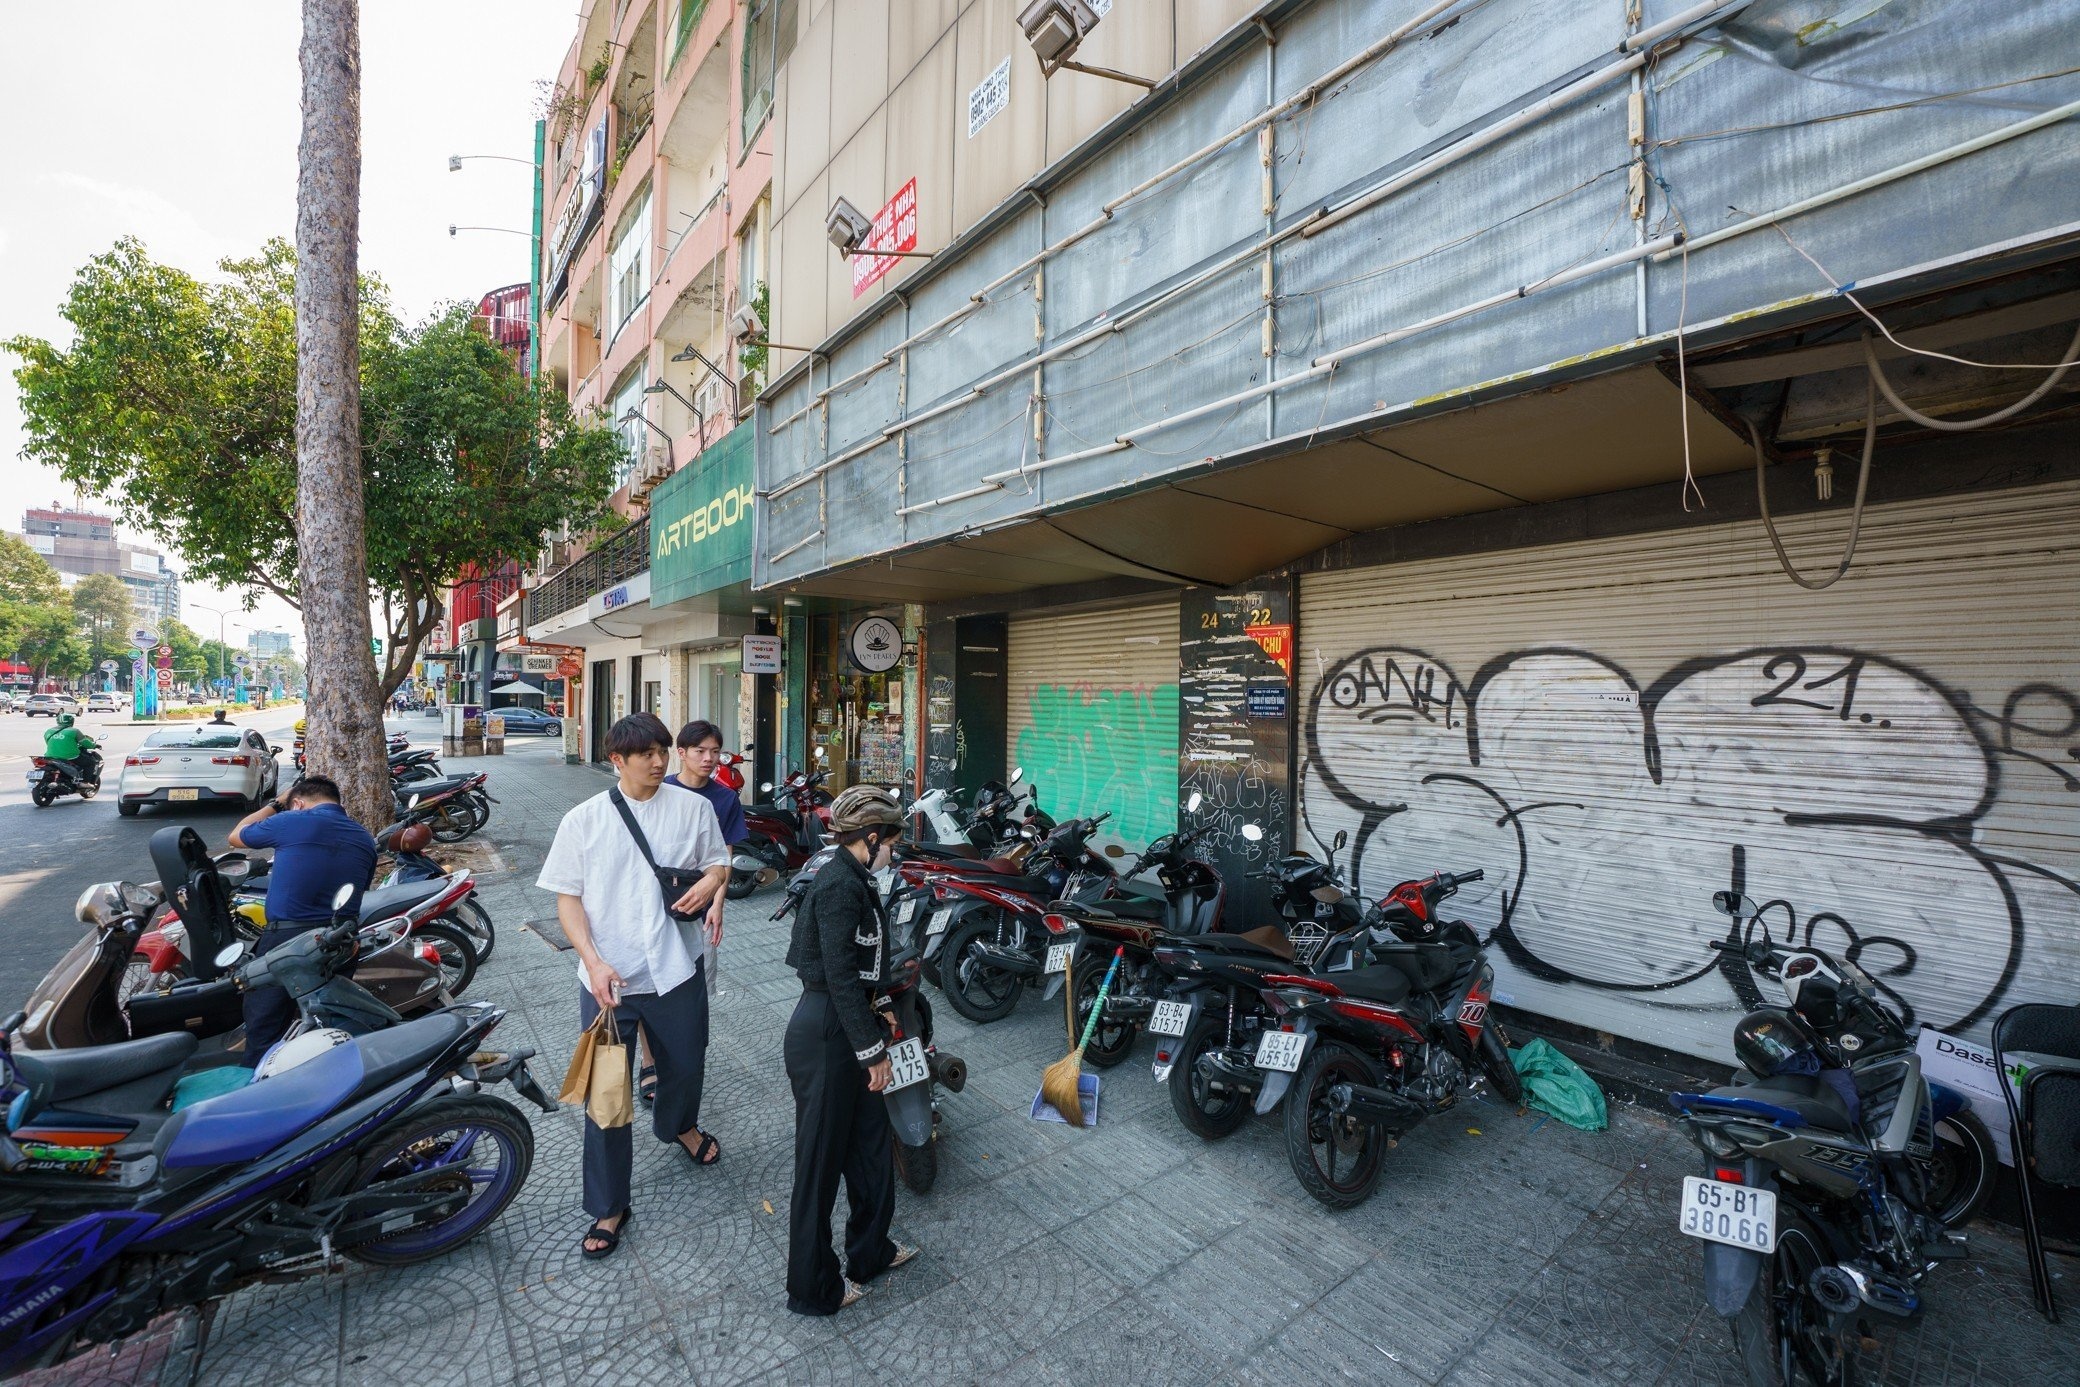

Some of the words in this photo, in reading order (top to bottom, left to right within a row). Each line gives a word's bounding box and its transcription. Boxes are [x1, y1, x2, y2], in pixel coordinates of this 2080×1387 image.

[895, 182, 916, 220] NHÀ
[657, 483, 755, 560] ARTBOOK
[1200, 612, 1220, 630] 24
[1249, 607, 1271, 627] 22
[1158, 1002, 1183, 1019] 63-B4
[1458, 1003, 1487, 1023] 10
[1151, 1018, 1184, 1034] 815.71
[1267, 1034, 1299, 1051] 85-E1
[1258, 1050, 1297, 1069] 055.94
[1935, 1038, 2022, 1077] Dasani
[1697, 1182, 1758, 1217] 65-B1
[1686, 1206, 1769, 1247] 380.66
[0, 1284, 64, 1327] AMAHA
